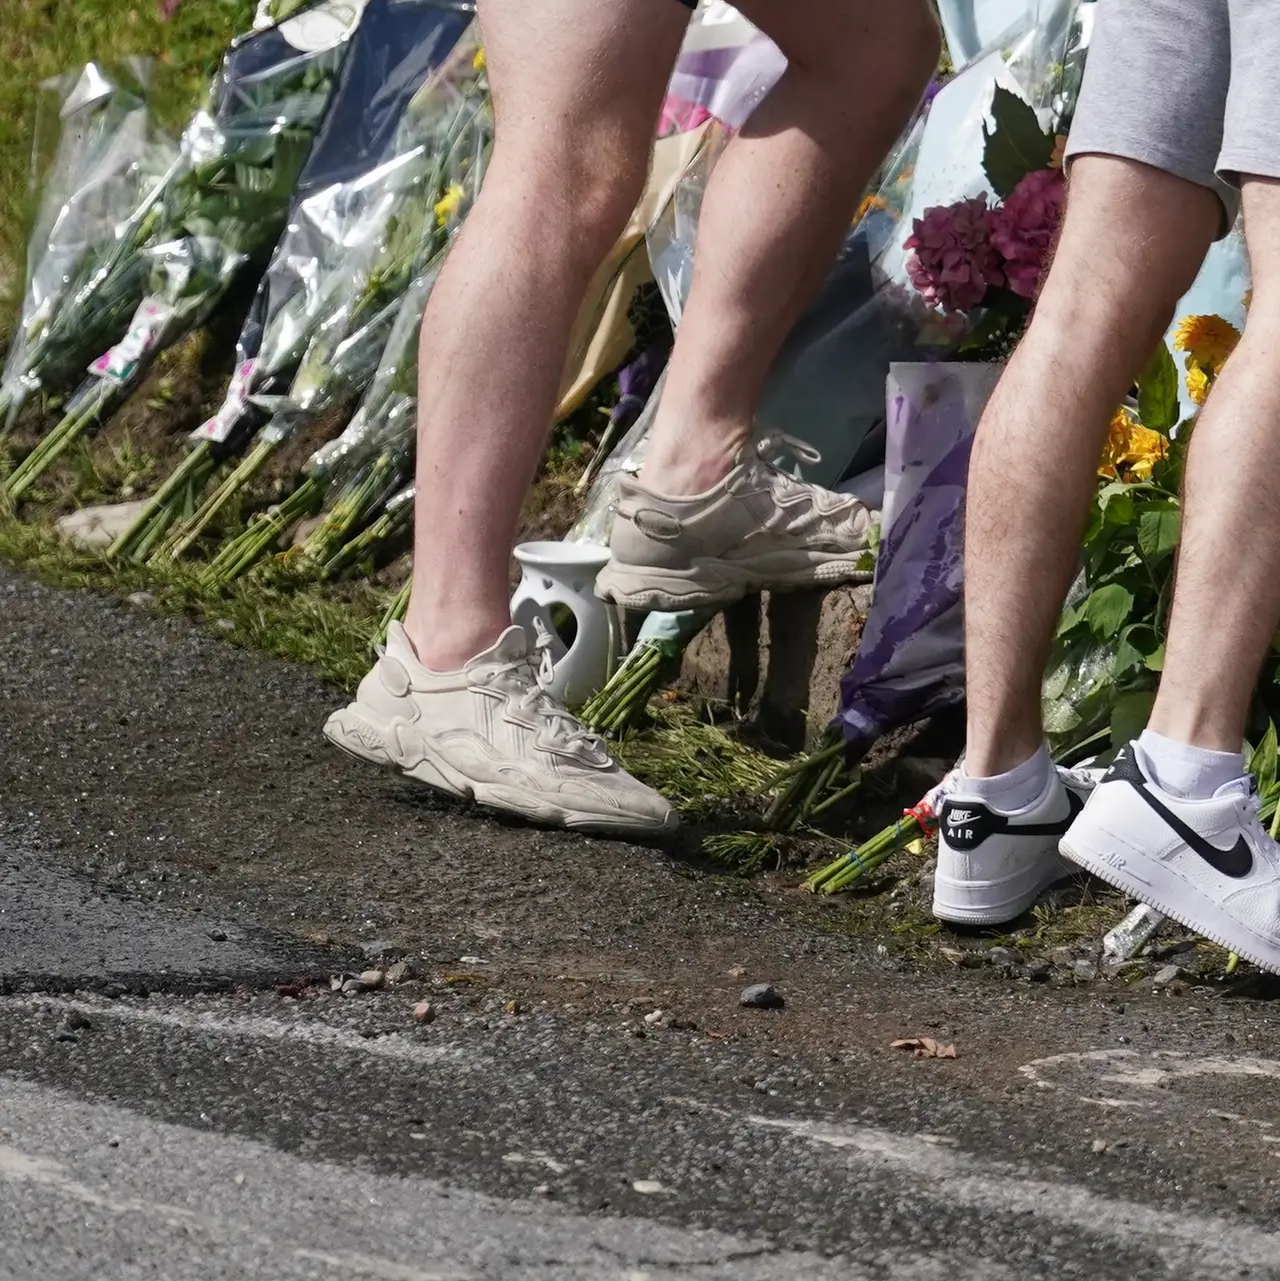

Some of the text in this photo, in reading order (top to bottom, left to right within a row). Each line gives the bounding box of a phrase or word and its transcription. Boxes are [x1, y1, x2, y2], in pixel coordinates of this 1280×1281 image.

[950, 808, 972, 821] NIKE
[947, 828, 974, 840] AIR
[1102, 852, 1127, 872] AIR
